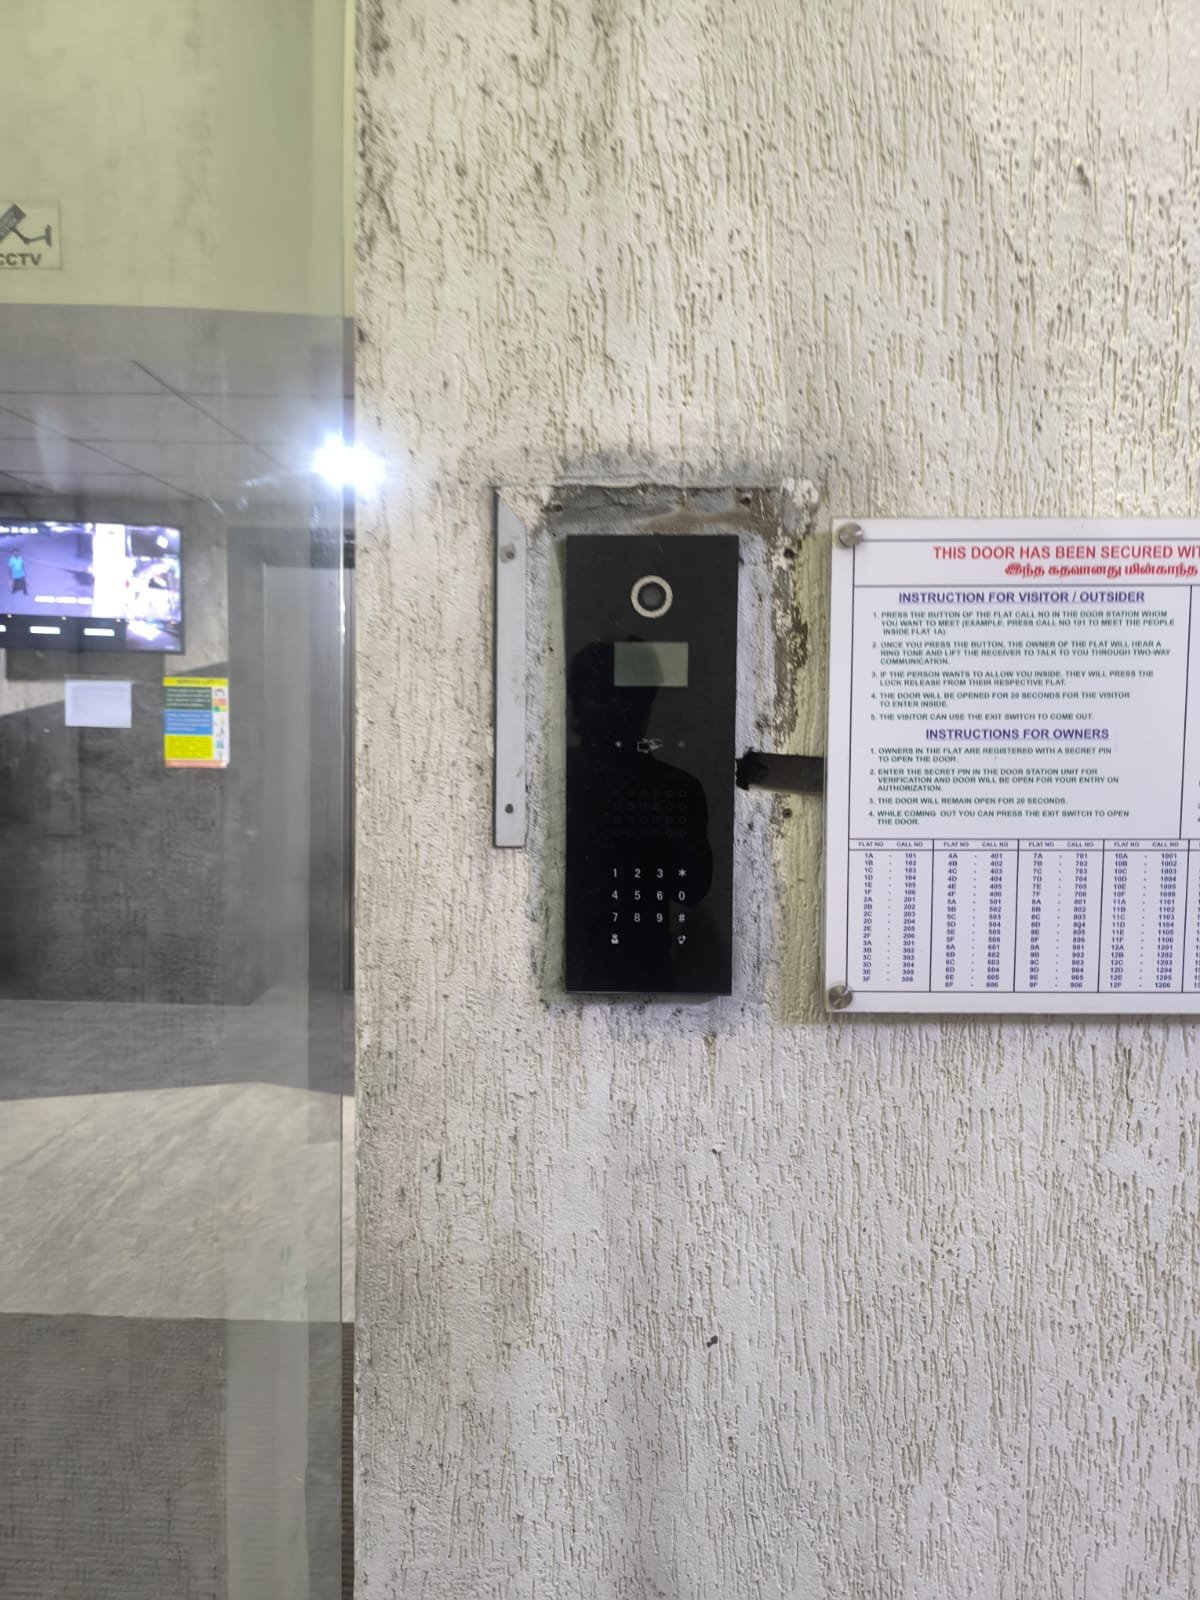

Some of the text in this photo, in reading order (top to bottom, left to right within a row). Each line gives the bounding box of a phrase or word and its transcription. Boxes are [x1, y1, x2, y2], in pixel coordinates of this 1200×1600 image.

[933, 547, 967, 559] THIS
[971, 547, 1016, 559] DOOR
[1020, 547, 1051, 559] HAS
[1055, 546, 1096, 558] BEEN
[1100, 546, 1174, 558] SECURED
[898, 592, 1146, 603] INSTRUCTION FOR VISITOR / OUTSIDER
[925, 729, 1110, 740] INSTRUCTIONS FOR OWNERS
[613, 868, 663, 878] 1 2 3
[612, 890, 685, 900] 4 5 6 0
[612, 912, 685, 922] 7 8 9 #
